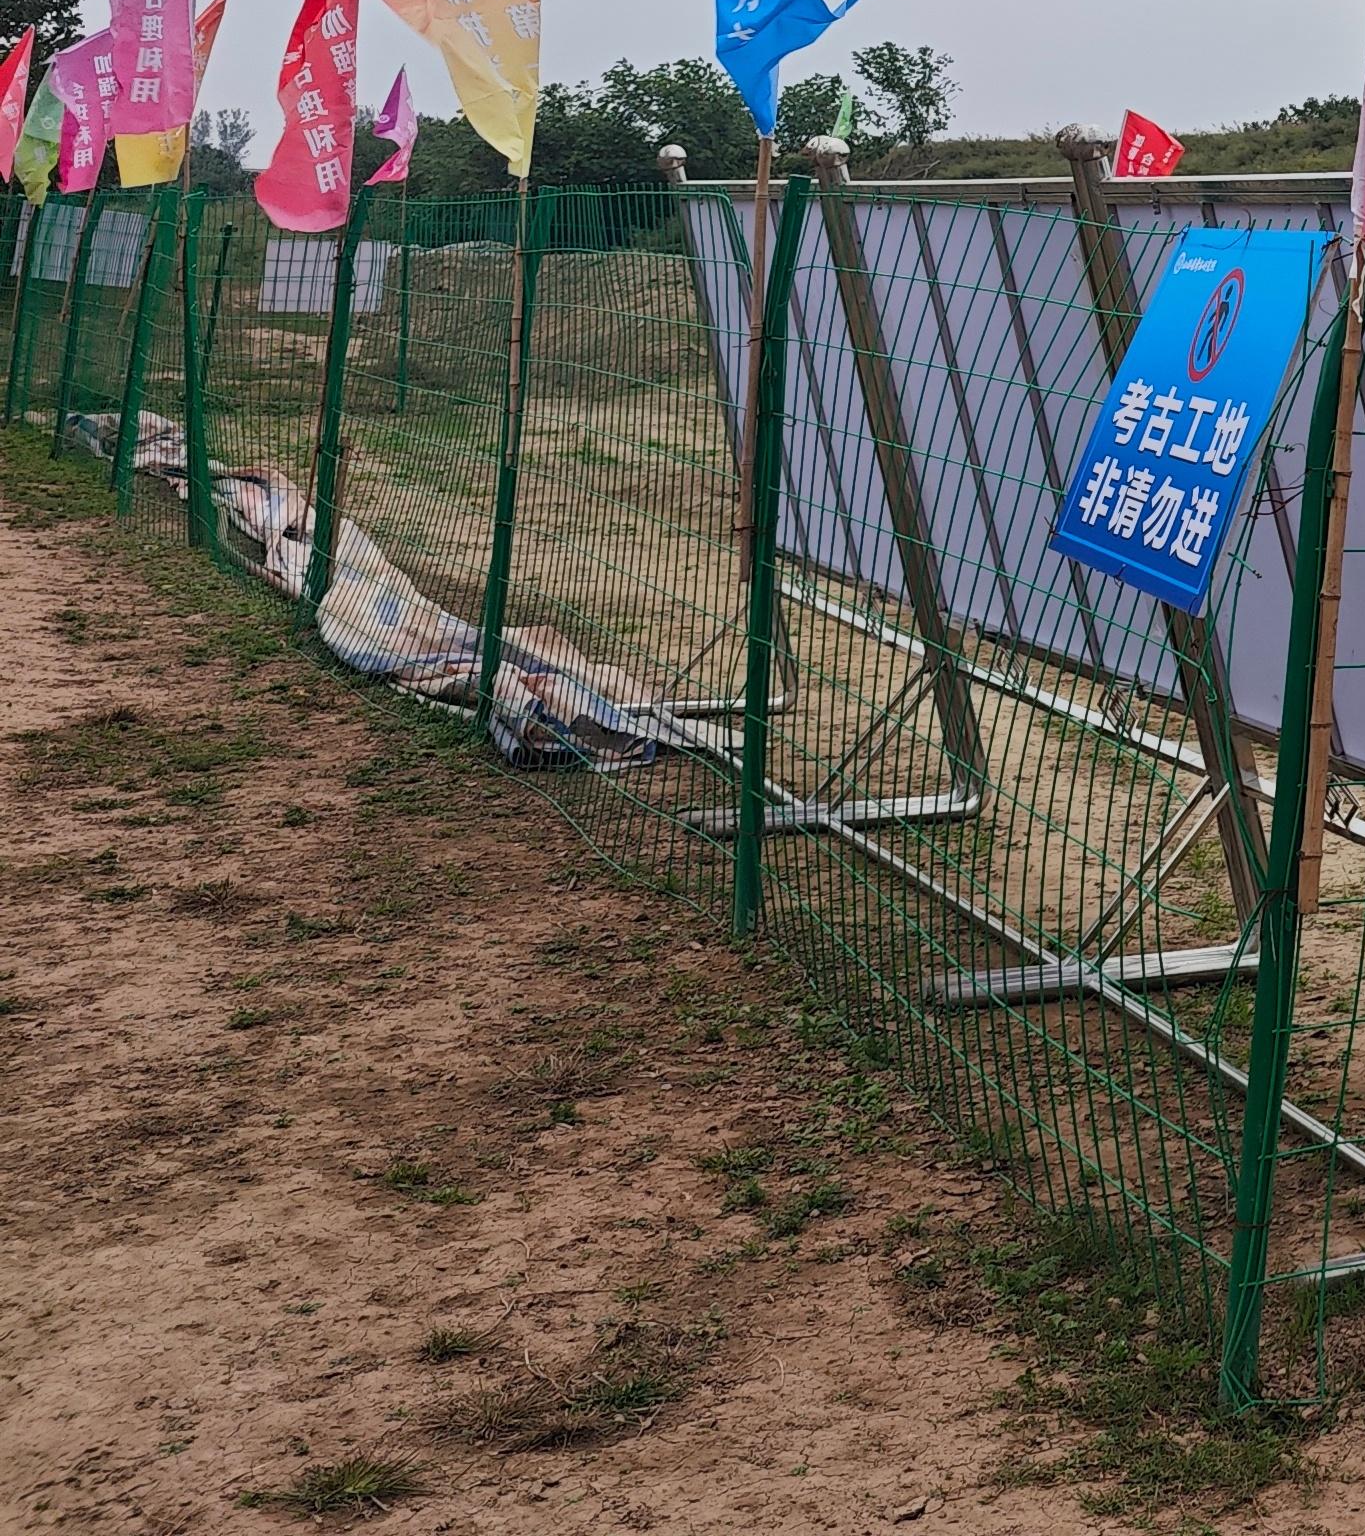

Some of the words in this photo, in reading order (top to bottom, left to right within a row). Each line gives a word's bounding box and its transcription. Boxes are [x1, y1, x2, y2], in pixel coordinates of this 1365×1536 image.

[1112, 378, 1251, 476] 考古工地
[1079, 455, 1220, 567] 非请勿进
